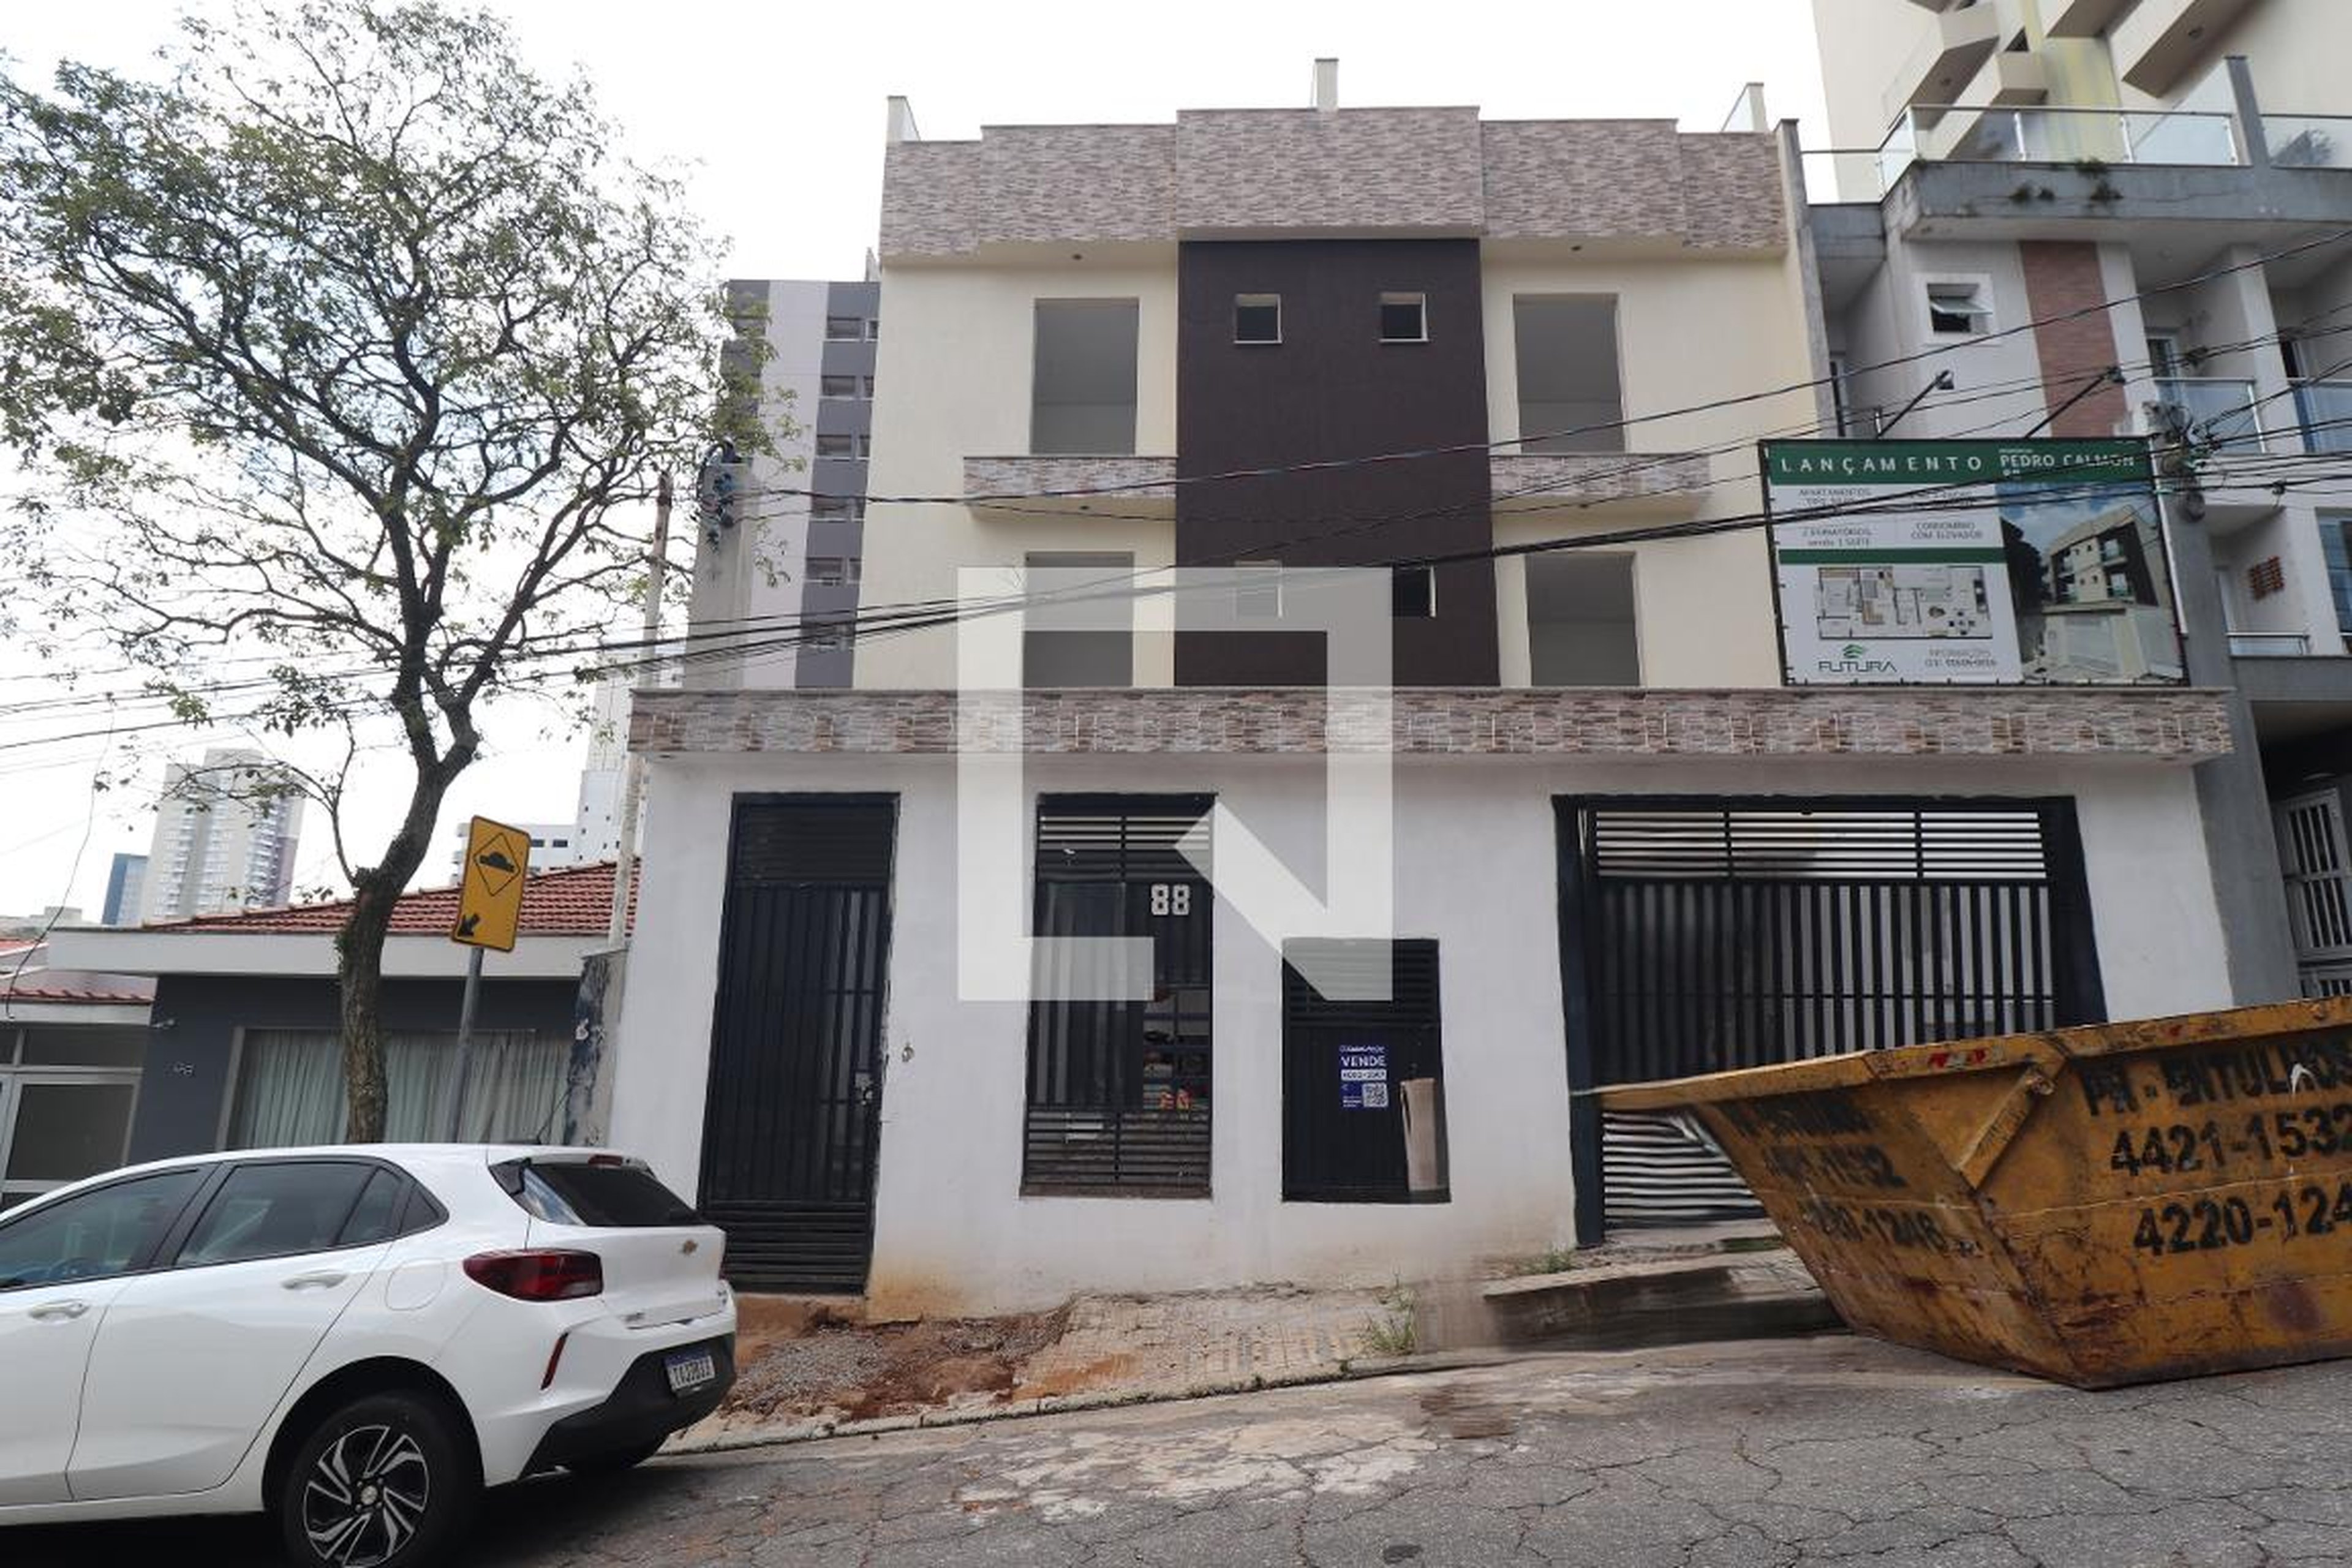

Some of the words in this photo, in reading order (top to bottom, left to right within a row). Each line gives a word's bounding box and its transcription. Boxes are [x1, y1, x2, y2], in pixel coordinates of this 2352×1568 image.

[1781, 456, 1982, 475] LANÇAMENTO
[1999, 454, 2055, 468] PEDRO
[1818, 660, 1898, 673] FUTURA
[1151, 884, 1190, 916] 88
